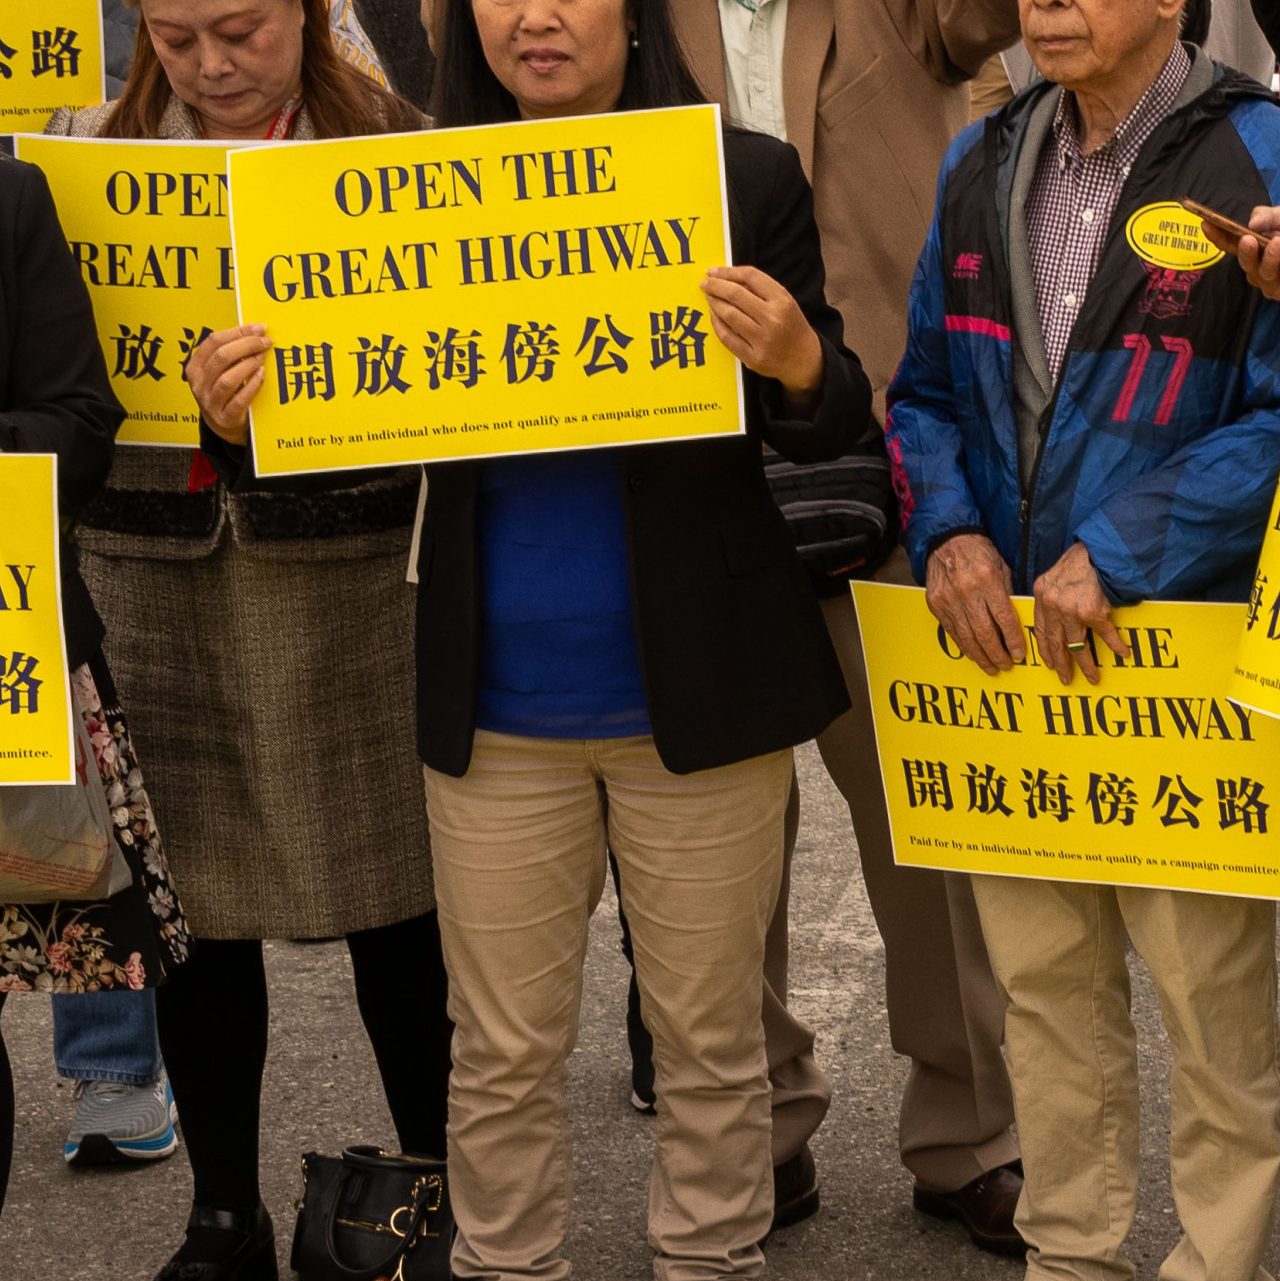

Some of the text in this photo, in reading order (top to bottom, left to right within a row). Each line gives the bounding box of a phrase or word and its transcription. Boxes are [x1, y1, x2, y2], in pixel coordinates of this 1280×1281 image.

[335, 146, 616, 216] OPEN THE
[263, 217, 699, 302] GREAT HIGHWAY
[1142, 232, 1208, 254] GREAT HIGHWAY
[1159, 220, 1200, 237] OPEN THE
[70, 241, 198, 290] REAT
[274, 306, 708, 405] 開放海傍公路
[276, 402, 722, 449] Paid for by an individual who does not qualify as a campaign committee.
[889, 680, 1256, 742] GREAT HIGHWAY
[902, 758, 1269, 834] 開放海傍公路
